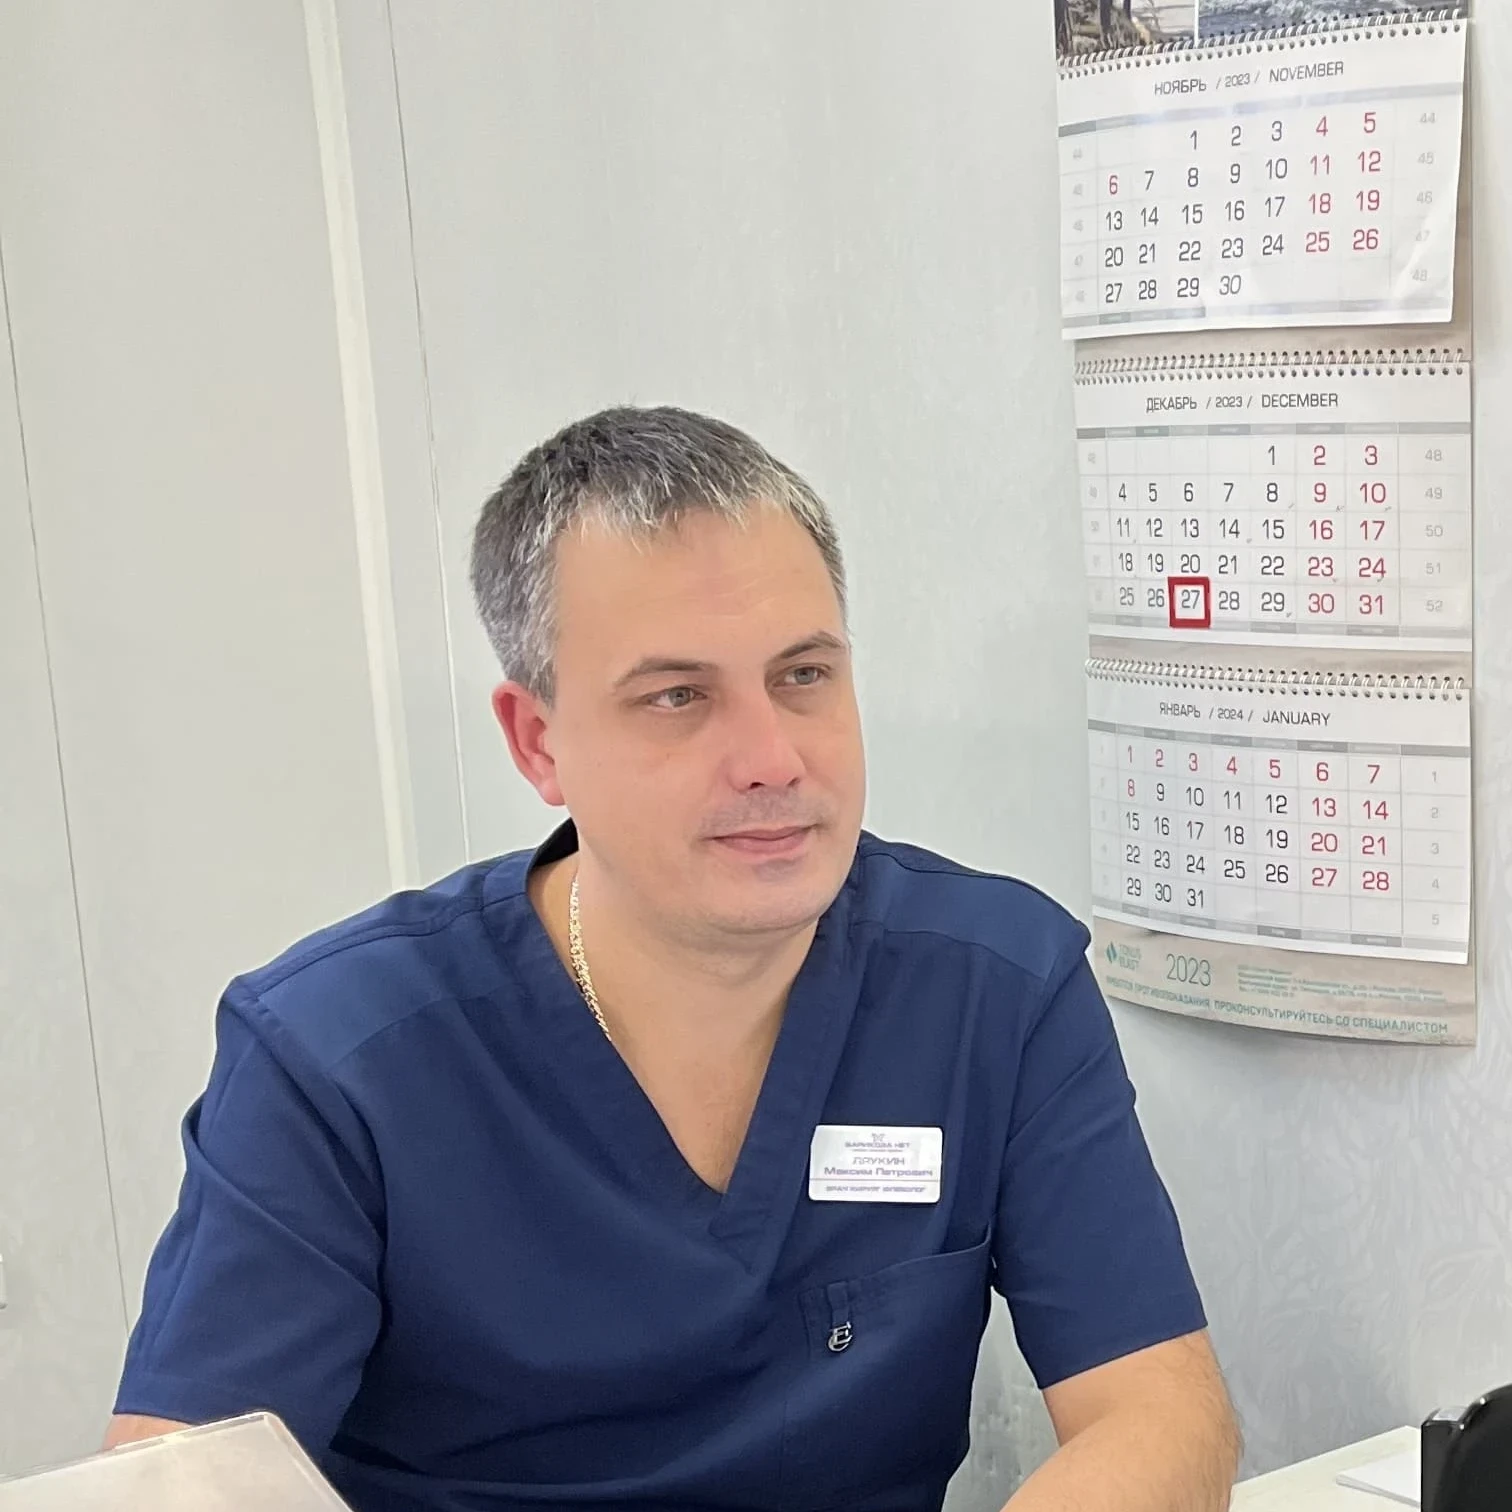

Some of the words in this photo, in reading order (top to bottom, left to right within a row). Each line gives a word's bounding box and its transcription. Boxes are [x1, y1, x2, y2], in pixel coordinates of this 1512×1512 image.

[1154, 78, 1207, 96] НОЯБРЬ
[1225, 73, 1251, 89] 2023
[1269, 61, 1345, 84] NOVEMBER
[1189, 130, 1198, 151] 1
[1230, 125, 1242, 147] 2
[1271, 120, 1283, 142] 3
[1315, 115, 1329, 137] 4
[1363, 111, 1377, 134] 5
[1108, 174, 1118, 196] 6
[1144, 169, 1155, 191] 7
[1187, 167, 1199, 188] 8
[1229, 163, 1241, 184] 9
[1265, 157, 1288, 180] 10
[1309, 154, 1330, 176] 11
[1357, 150, 1381, 173] 12
[1105, 210, 1123, 232] 13
[1140, 206, 1160, 228] 14
[1181, 203, 1203, 225] 15
[1224, 199, 1245, 222] 16
[1264, 195, 1286, 218] 17
[1308, 192, 1332, 215] 18
[1355, 189, 1380, 212] 19
[1104, 246, 1124, 268] 20
[1138, 242, 1156, 265] 21
[1178, 240, 1202, 262] 22
[1221, 237, 1244, 259] 23
[1262, 233, 1285, 256] 24
[1305, 231, 1330, 253] 25
[1352, 228, 1379, 251] 26
[1105, 282, 1123, 304] 27
[1138, 278, 1157, 301] 28
[1176, 277, 1200, 298] 29
[1218, 274, 1242, 296] 30
[1146, 396, 1198, 414] ДЕКАБРЬ
[1215, 395, 1243, 409] 2023
[1261, 393, 1339, 409] DECEMBER
[1267, 445, 1276, 466] 1
[1313, 444, 1326, 466] 2
[1364, 444, 1378, 466] 3
[1118, 482, 1127, 502] 4
[1148, 482, 1158, 503] 5
[1183, 482, 1194, 503] 6
[1223, 482, 1234, 503] 7
[1266, 482, 1279, 503] 8
[1313, 482, 1327, 503] 9
[1359, 482, 1387, 504] 10
[1116, 517, 1130, 538] 11
[1145, 517, 1164, 538] 12
[1180, 518, 1200, 539] 13
[1219, 518, 1241, 539] 14
[1262, 518, 1285, 540] 15
[1309, 519, 1334, 541] 16
[1359, 520, 1386, 541] 17
[1118, 552, 1134, 572] 18
[1147, 553, 1164, 573] 19
[1180, 553, 1201, 574] 20
[1218, 554, 1237, 575] 21
[1260, 555, 1285, 576] 22
[1307, 556, 1334, 577] 23
[1358, 557, 1387, 579] 24
[1119, 586, 1135, 607] 25
[1147, 588, 1166, 609] 26
[1180, 589, 1200, 610] 27
[1218, 590, 1240, 611] 28
[1261, 591, 1285, 612] 29
[1308, 592, 1335, 614] 30
[1359, 594, 1383, 615] 31
[1159, 702, 1201, 719] ЯНВАРЬ
[1217, 707, 1244, 721] 2024
[1263, 709, 1331, 727] JANUARY
[1127, 744, 1133, 763] 1
[1155, 748, 1164, 768] 2
[1188, 752, 1199, 772] 3
[1226, 756, 1238, 775] 4
[1269, 758, 1281, 779] 5
[1316, 761, 1329, 782] 6
[1367, 764, 1381, 784] 7
[1127, 778, 1136, 798] 8
[1156, 782, 1165, 802] 9
[1185, 786, 1205, 807] 10
[1223, 790, 1241, 811] 11
[1266, 793, 1288, 815] 12
[1311, 796, 1337, 818] 13
[1362, 799, 1389, 821] 14
[1125, 811, 1140, 832] 15
[1153, 816, 1170, 836] 16
[1186, 820, 1205, 841] 17
[1224, 824, 1245, 846] 18
[1266, 828, 1289, 850] 19
[1311, 832, 1338, 853] 20
[1361, 835, 1386, 856] 21
[1126, 843, 1141, 864] 22
[1153, 849, 1171, 870] 23
[1186, 854, 1206, 874] 24
[1223, 859, 1246, 880] 25
[1265, 863, 1289, 884] 26
[1311, 867, 1338, 888] 27
[1362, 870, 1390, 892] 28
[1126, 876, 1142, 897] 29
[1154, 882, 1172, 903] 30
[1186, 887, 1204, 908] 31
[1165, 953, 1212, 987] 2023
[1214, 999, 1334, 1024] ПРОКОНСУЛЬТИРУЙТЕСЬ
[1335, 1015, 1350, 1026] СО
[1352, 1017, 1448, 1034] СПЕЦИАЛИСТОМ
[823, 1166, 873, 1176] Максим
[875, 1167, 933, 1177] Петрович
